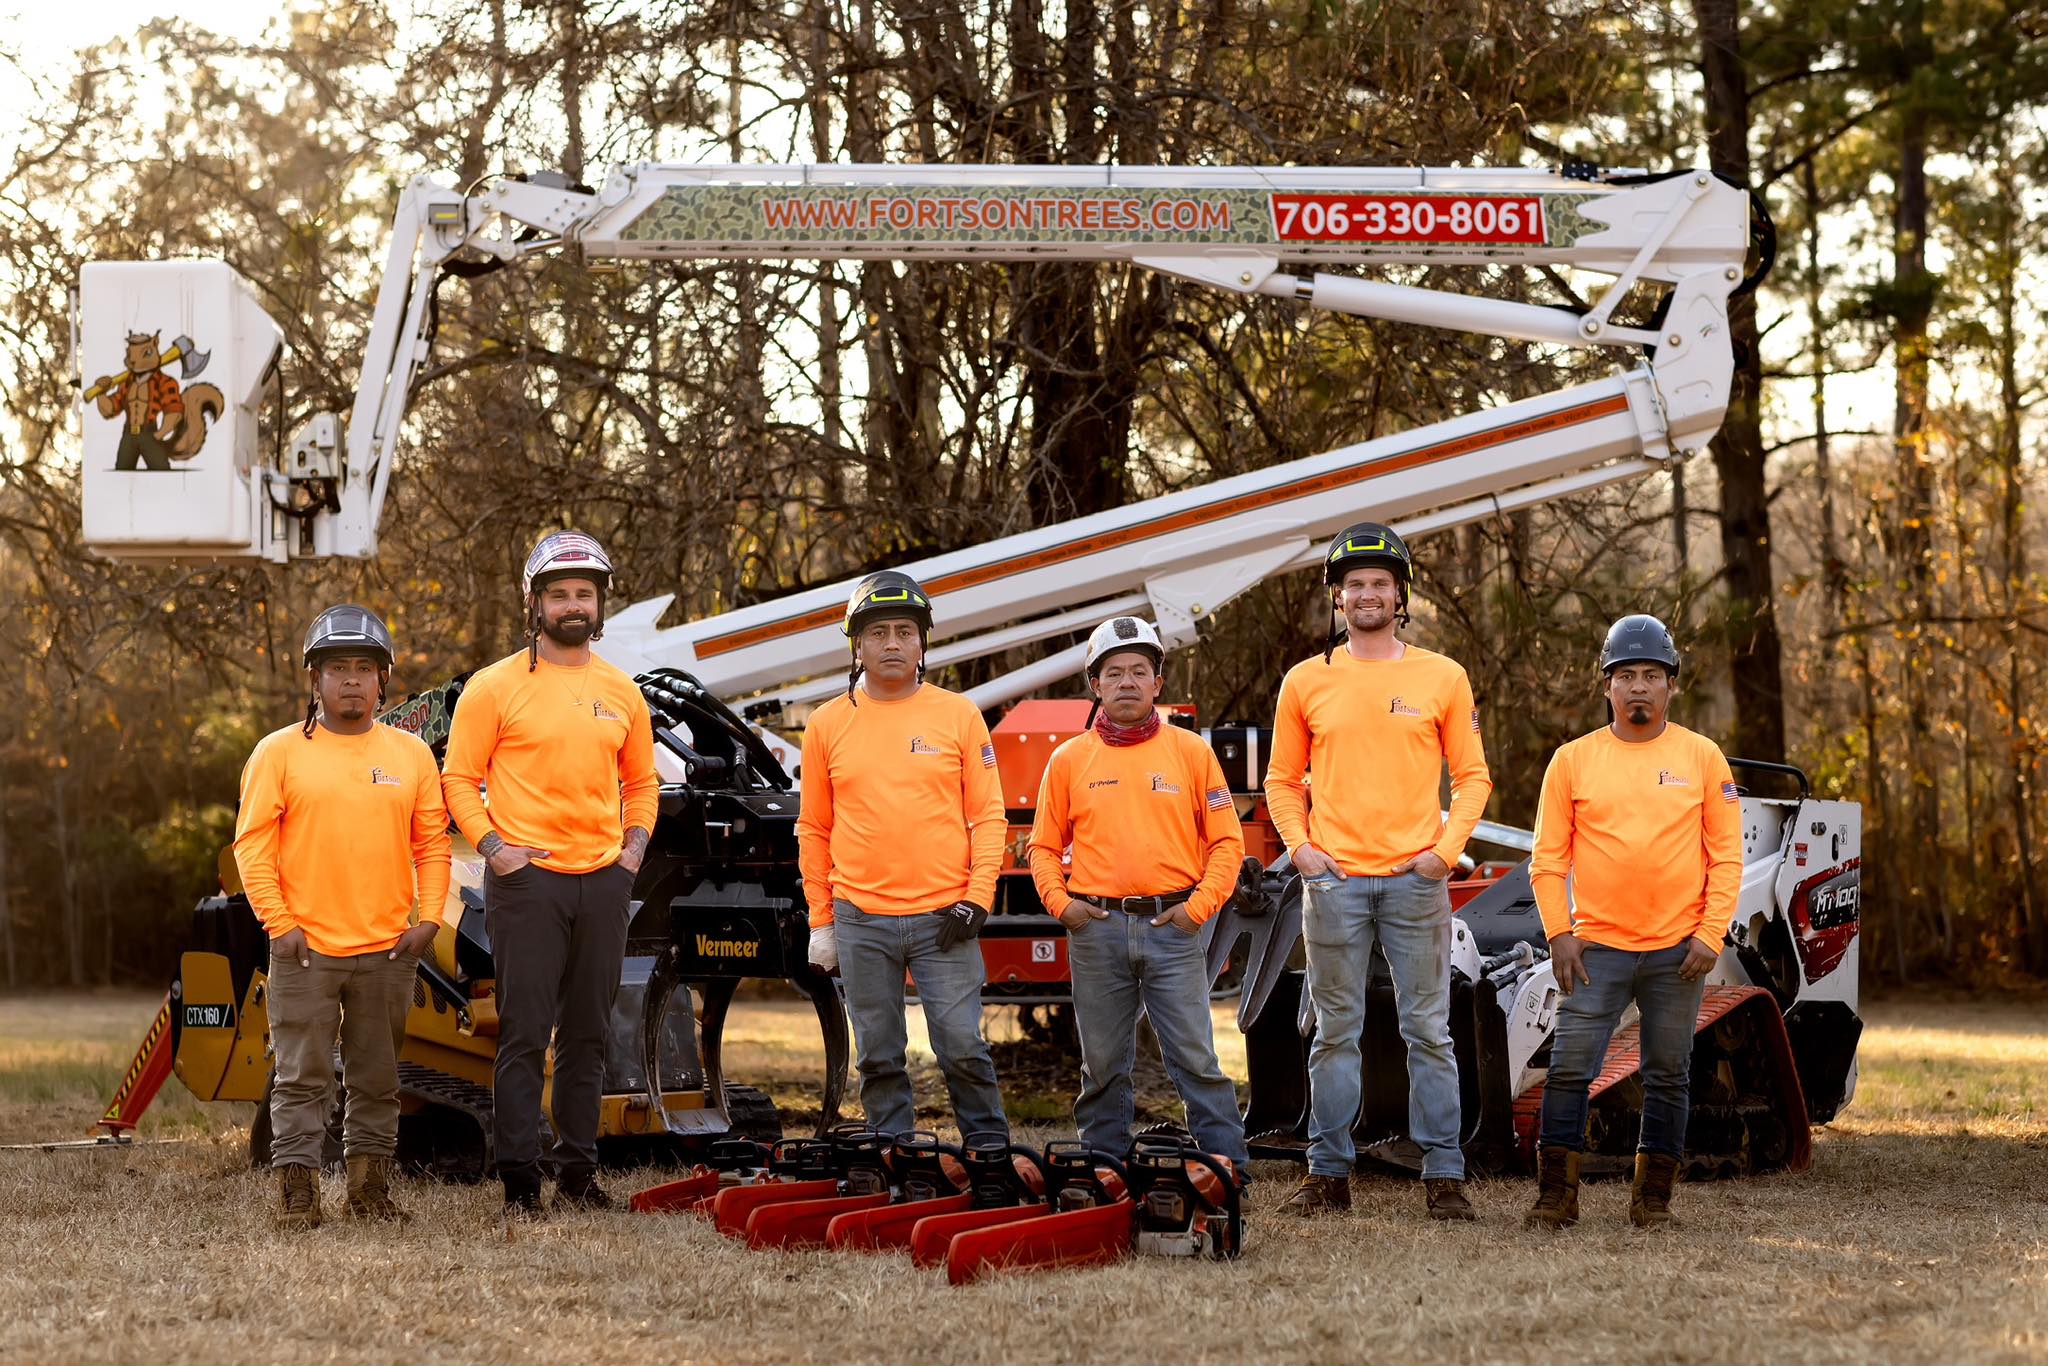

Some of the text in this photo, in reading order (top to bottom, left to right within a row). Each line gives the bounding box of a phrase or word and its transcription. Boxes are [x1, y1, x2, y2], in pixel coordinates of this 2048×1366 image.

[762, 198, 1231, 230] WWW.FORTSONTREES.COM
[1277, 201, 1539, 236] 706-330-8061
[695, 933, 759, 958] Vermeer
